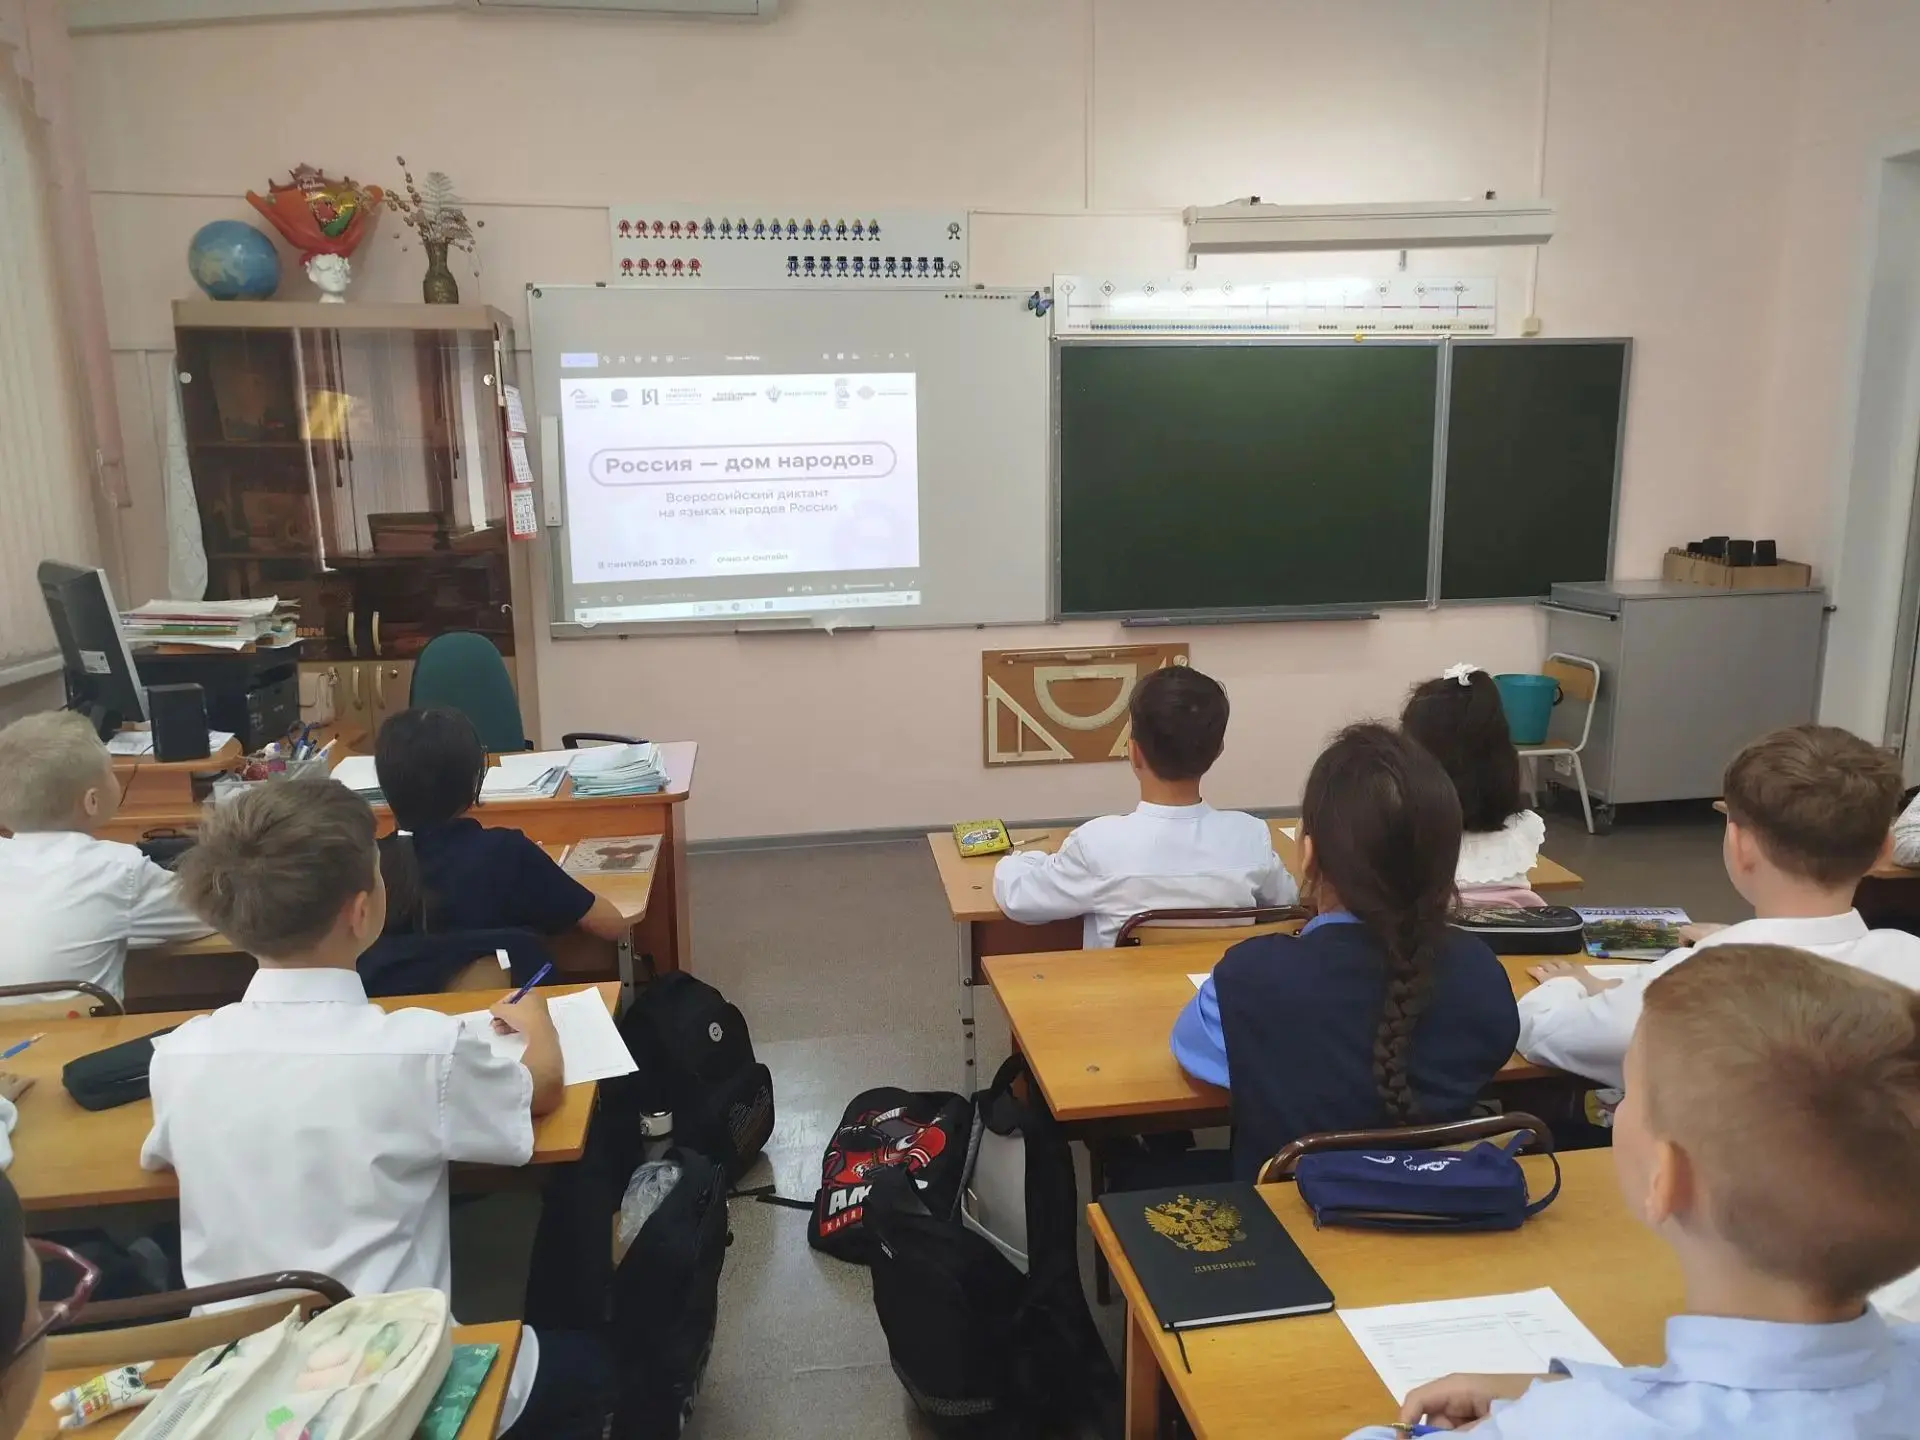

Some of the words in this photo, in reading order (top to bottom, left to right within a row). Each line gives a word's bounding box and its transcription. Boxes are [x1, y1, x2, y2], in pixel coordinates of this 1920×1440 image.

[606, 457, 692, 474] Россия
[725, 456, 770, 473] дом
[778, 454, 874, 471] народов
[665, 489, 774, 504] Всероссийский
[776, 489, 829, 501] диктант
[658, 508, 675, 518] на
[679, 507, 726, 518] языках
[728, 504, 786, 516] народов
[789, 502, 838, 513] России
[1193, 1259, 1257, 1275] ДНЕВНИК
